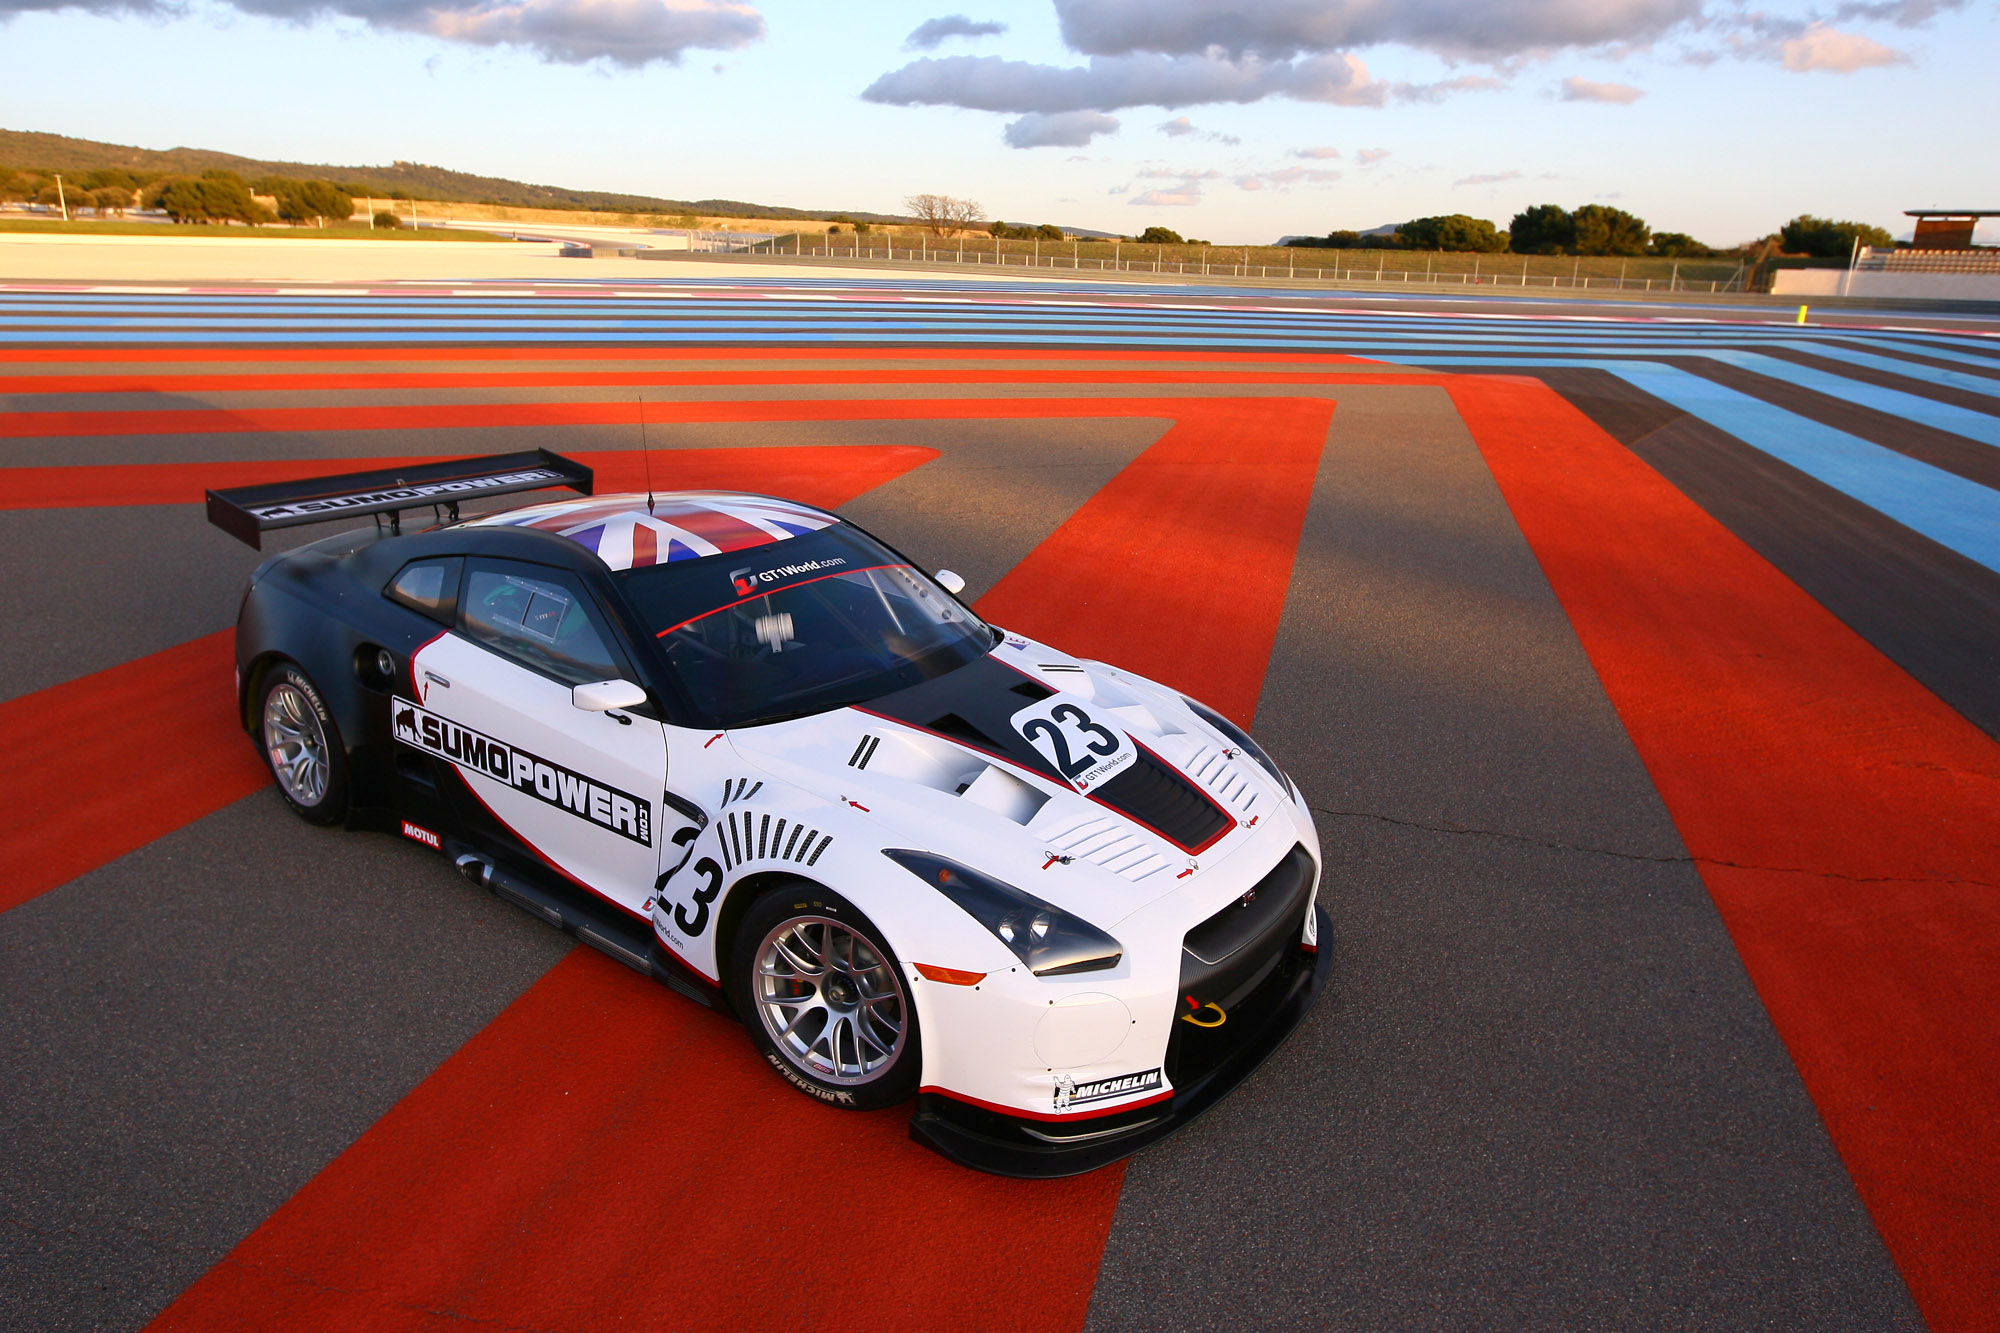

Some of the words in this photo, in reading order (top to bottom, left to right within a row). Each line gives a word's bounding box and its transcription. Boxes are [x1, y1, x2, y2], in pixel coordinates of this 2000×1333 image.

[759, 557, 846, 582] GT1World.com
[295, 675, 327, 721] MICHELIN
[1022, 703, 1120, 780] 23
[1085, 752, 1132, 781] GT1World.com
[404, 822, 439, 847] MOTUL
[768, 1054, 835, 1102] MICHELIN
[1075, 1071, 1159, 1099] MICHELIN
